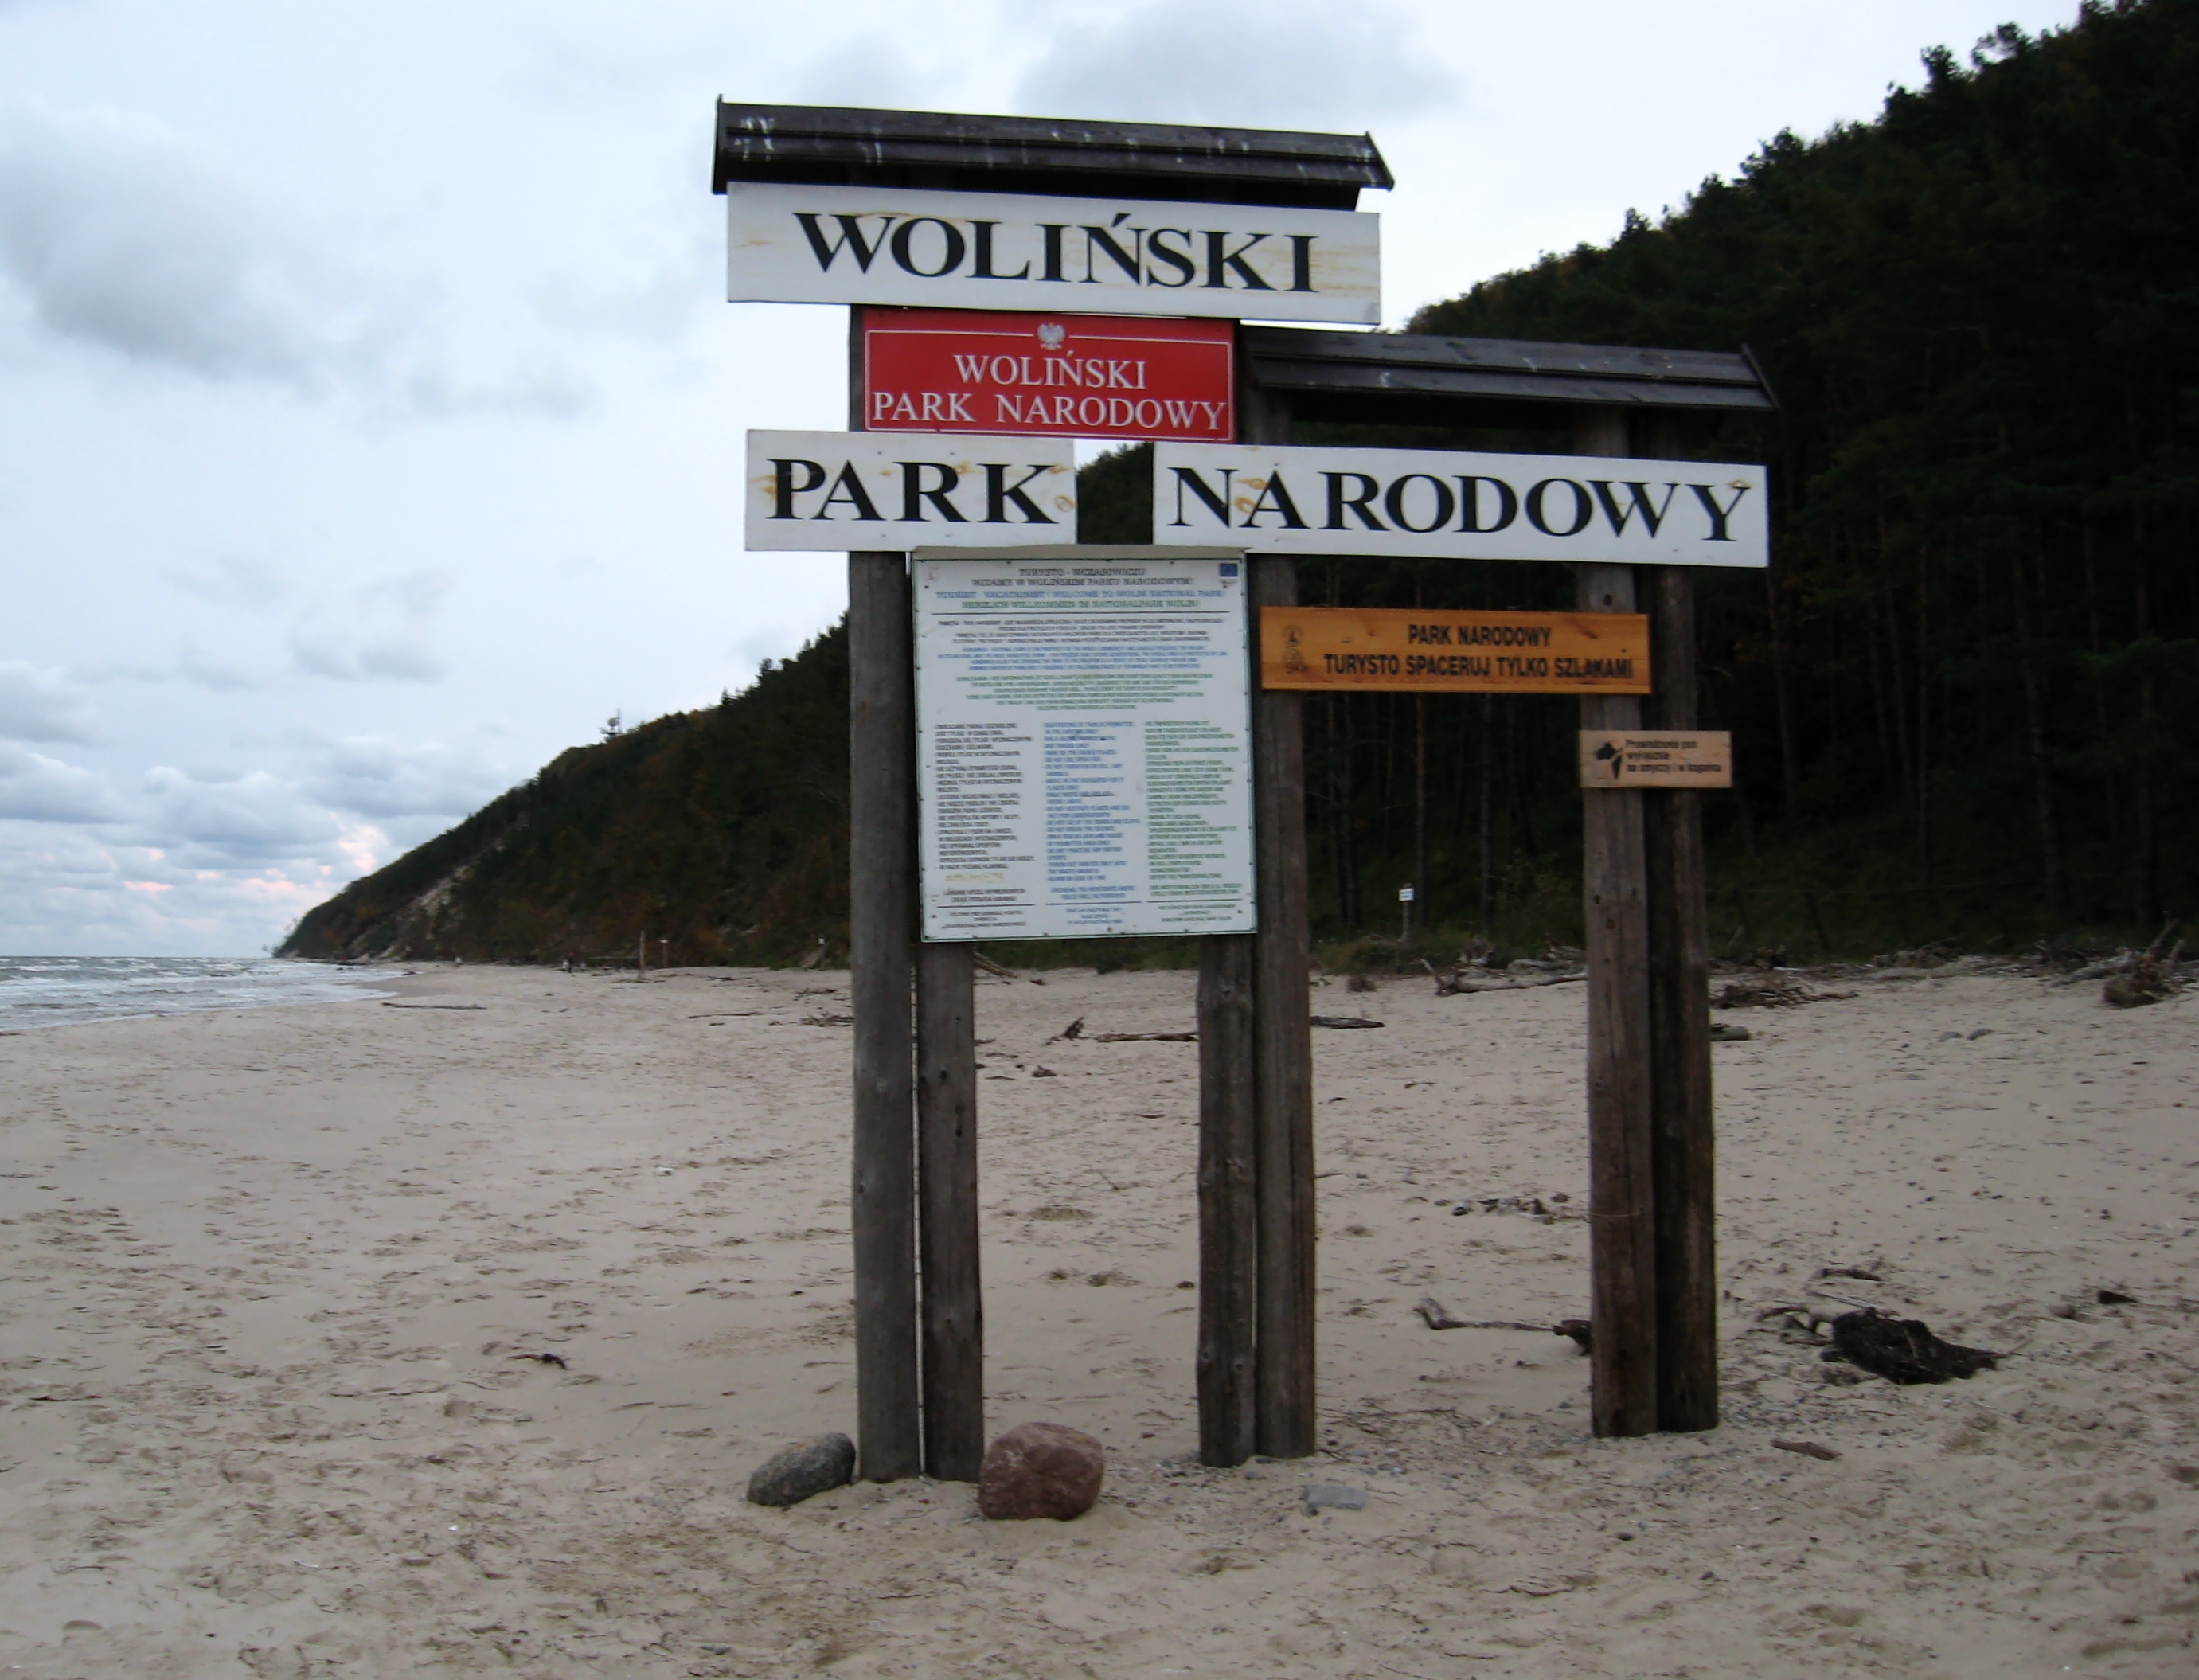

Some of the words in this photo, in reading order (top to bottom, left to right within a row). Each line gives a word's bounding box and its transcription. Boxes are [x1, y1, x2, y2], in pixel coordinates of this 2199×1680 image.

[793, 212, 1319, 294] WOLIŃSKI
[954, 350, 1146, 389] WOLIŃSKI
[873, 391, 975, 423] PARK
[995, 394, 1226, 430] NARODOWY
[766, 459, 1060, 525] PARK
[1168, 467, 1752, 541] NARODOWY
[1408, 624, 1451, 645] PARK
[1458, 625, 1551, 647] NARODOWY
[1323, 654, 1400, 674] TURYSTO
[1406, 655, 1490, 676] SPACERUJ
[1497, 658, 1548, 677] TYLKO
[1554, 658, 1633, 678] SZLAKAMI
